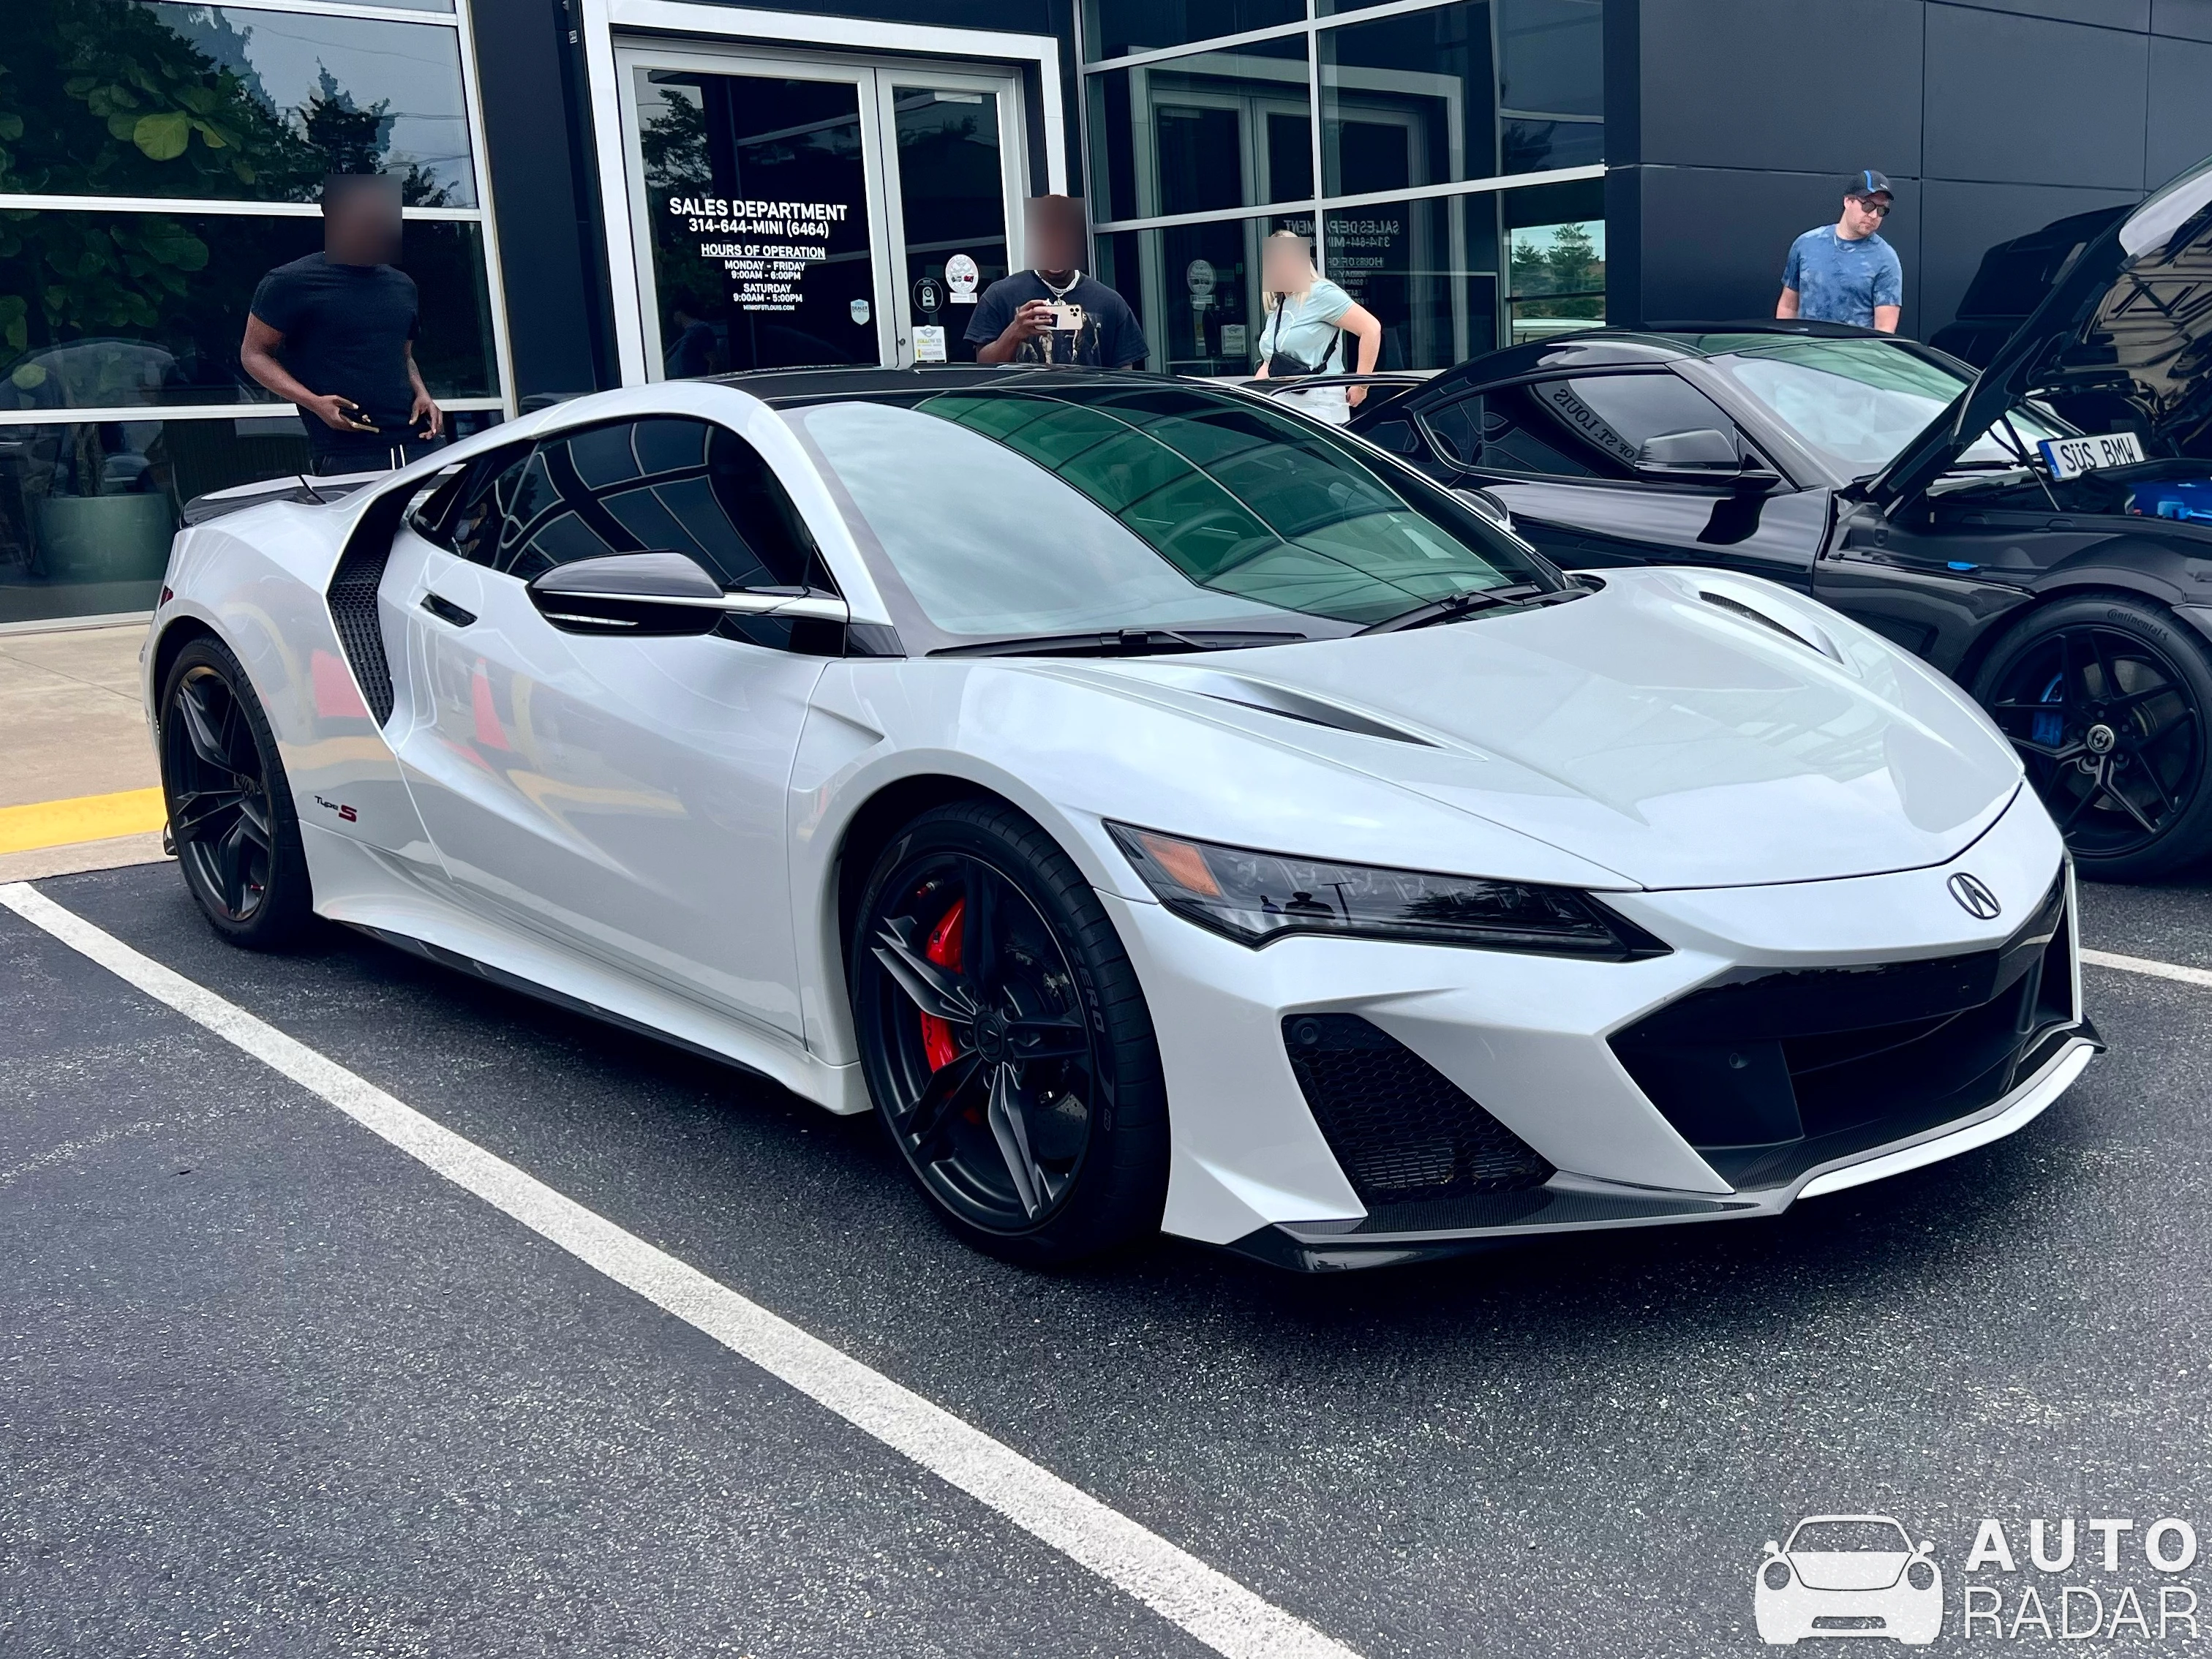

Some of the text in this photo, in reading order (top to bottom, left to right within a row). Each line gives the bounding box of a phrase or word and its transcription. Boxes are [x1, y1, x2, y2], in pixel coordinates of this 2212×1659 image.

[669, 197, 848, 221] SALES DEPARTMENT
[688, 217, 830, 238] 314-644-MINI (6464)
[701, 244, 826, 259] HOURS OF OPERATION
[724, 260, 764, 271] MONDAY
[772, 260, 805, 271] FRIDAY
[731, 270, 763, 279] 9:00AM
[770, 271, 802, 280] 6:00PM
[743, 282, 791, 293] SATURDAY
[733, 293, 765, 302] 9:00AM
[772, 293, 803, 303] 5:00PM
[2060, 437, 2137, 473] SÜS BMW
[314, 795, 358, 823] Type S
[1069, 946, 1106, 1034] ZERO
